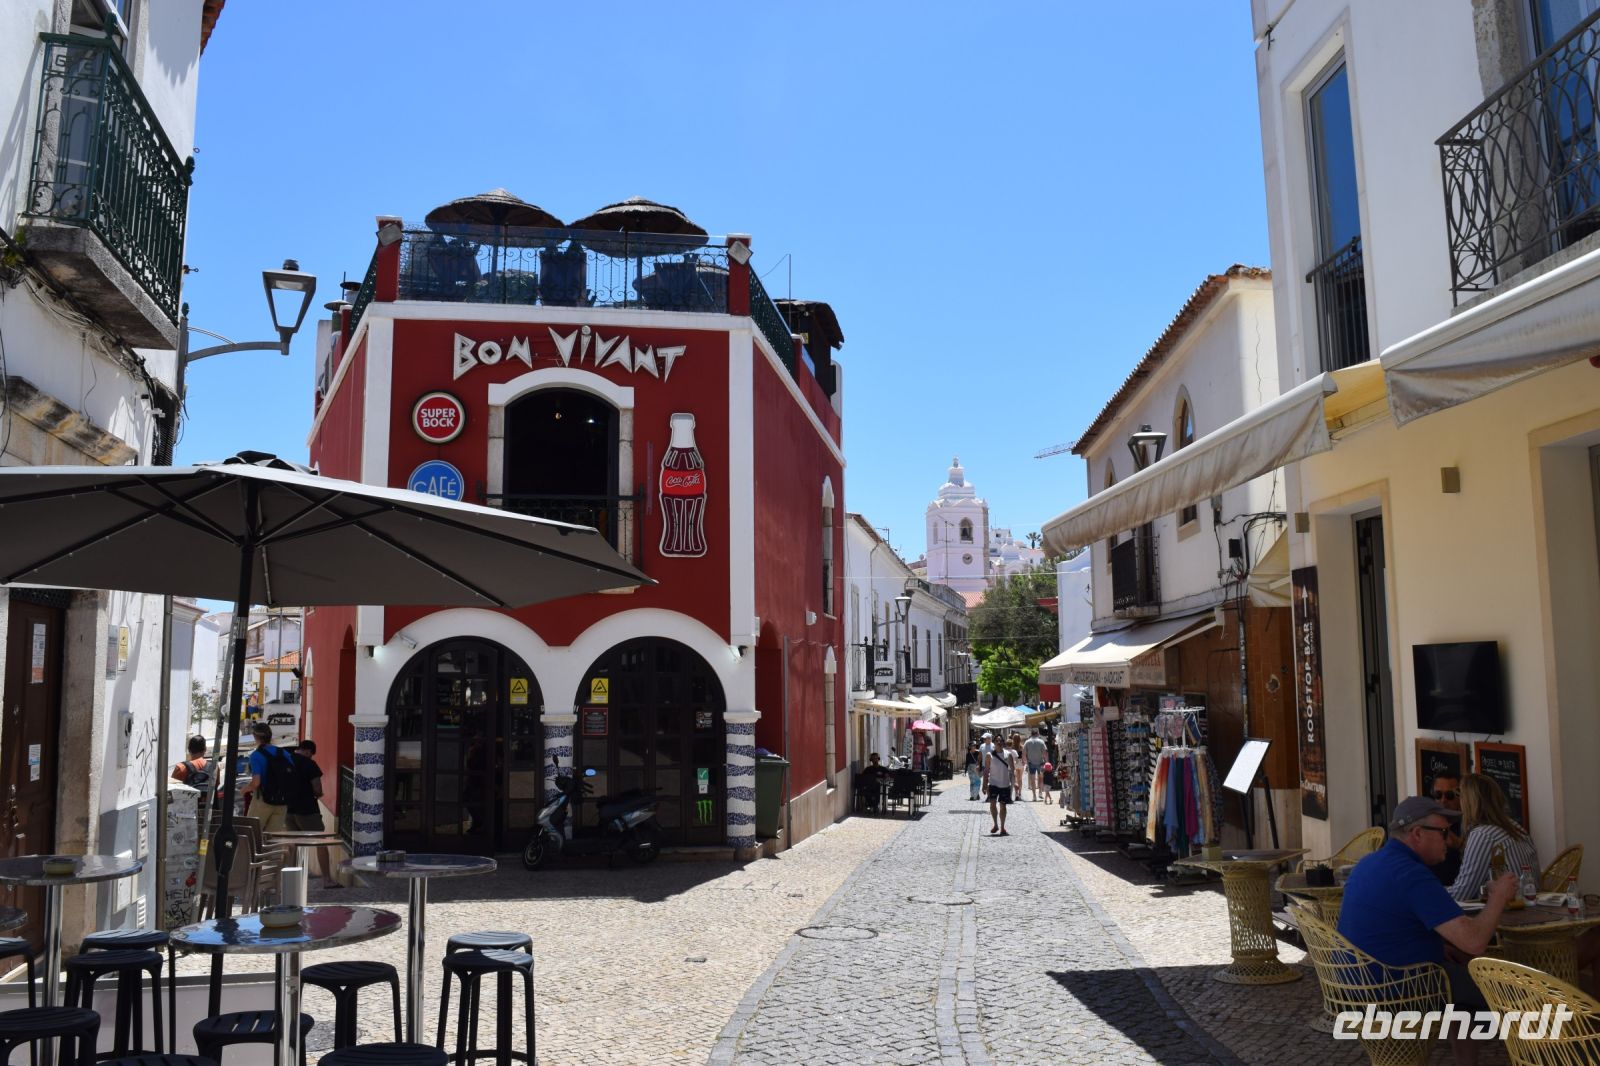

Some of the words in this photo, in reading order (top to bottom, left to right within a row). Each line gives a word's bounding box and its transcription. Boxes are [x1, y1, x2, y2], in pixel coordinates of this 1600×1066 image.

[453, 332, 533, 381] BON
[420, 408, 457, 419] SUPER
[422, 416, 455, 428] BOCK
[413, 476, 457, 497] CAFÉ
[1303, 622, 1311, 656] BAR
[1305, 662, 1315, 743] ROOFTOP
